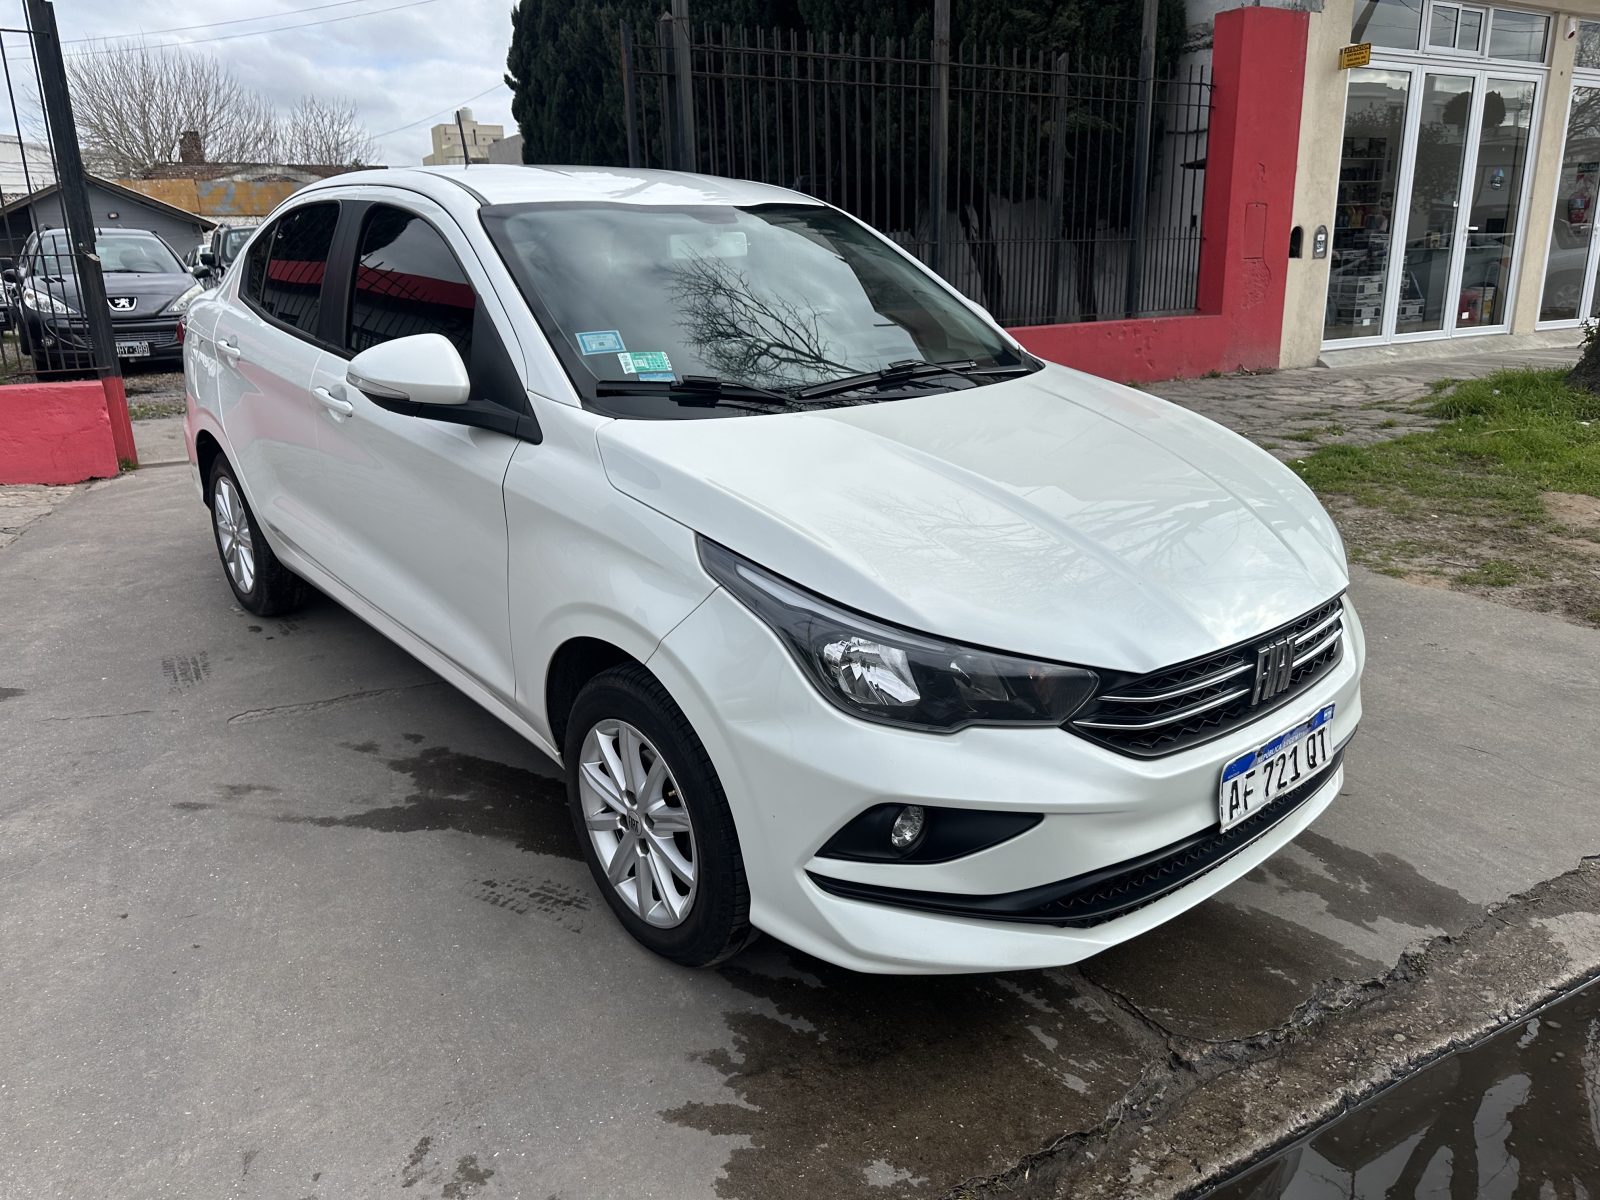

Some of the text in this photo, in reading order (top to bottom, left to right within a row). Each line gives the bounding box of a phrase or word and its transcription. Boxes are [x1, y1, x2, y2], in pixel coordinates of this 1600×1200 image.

[1229, 726, 1327, 821] AF 721 QT
